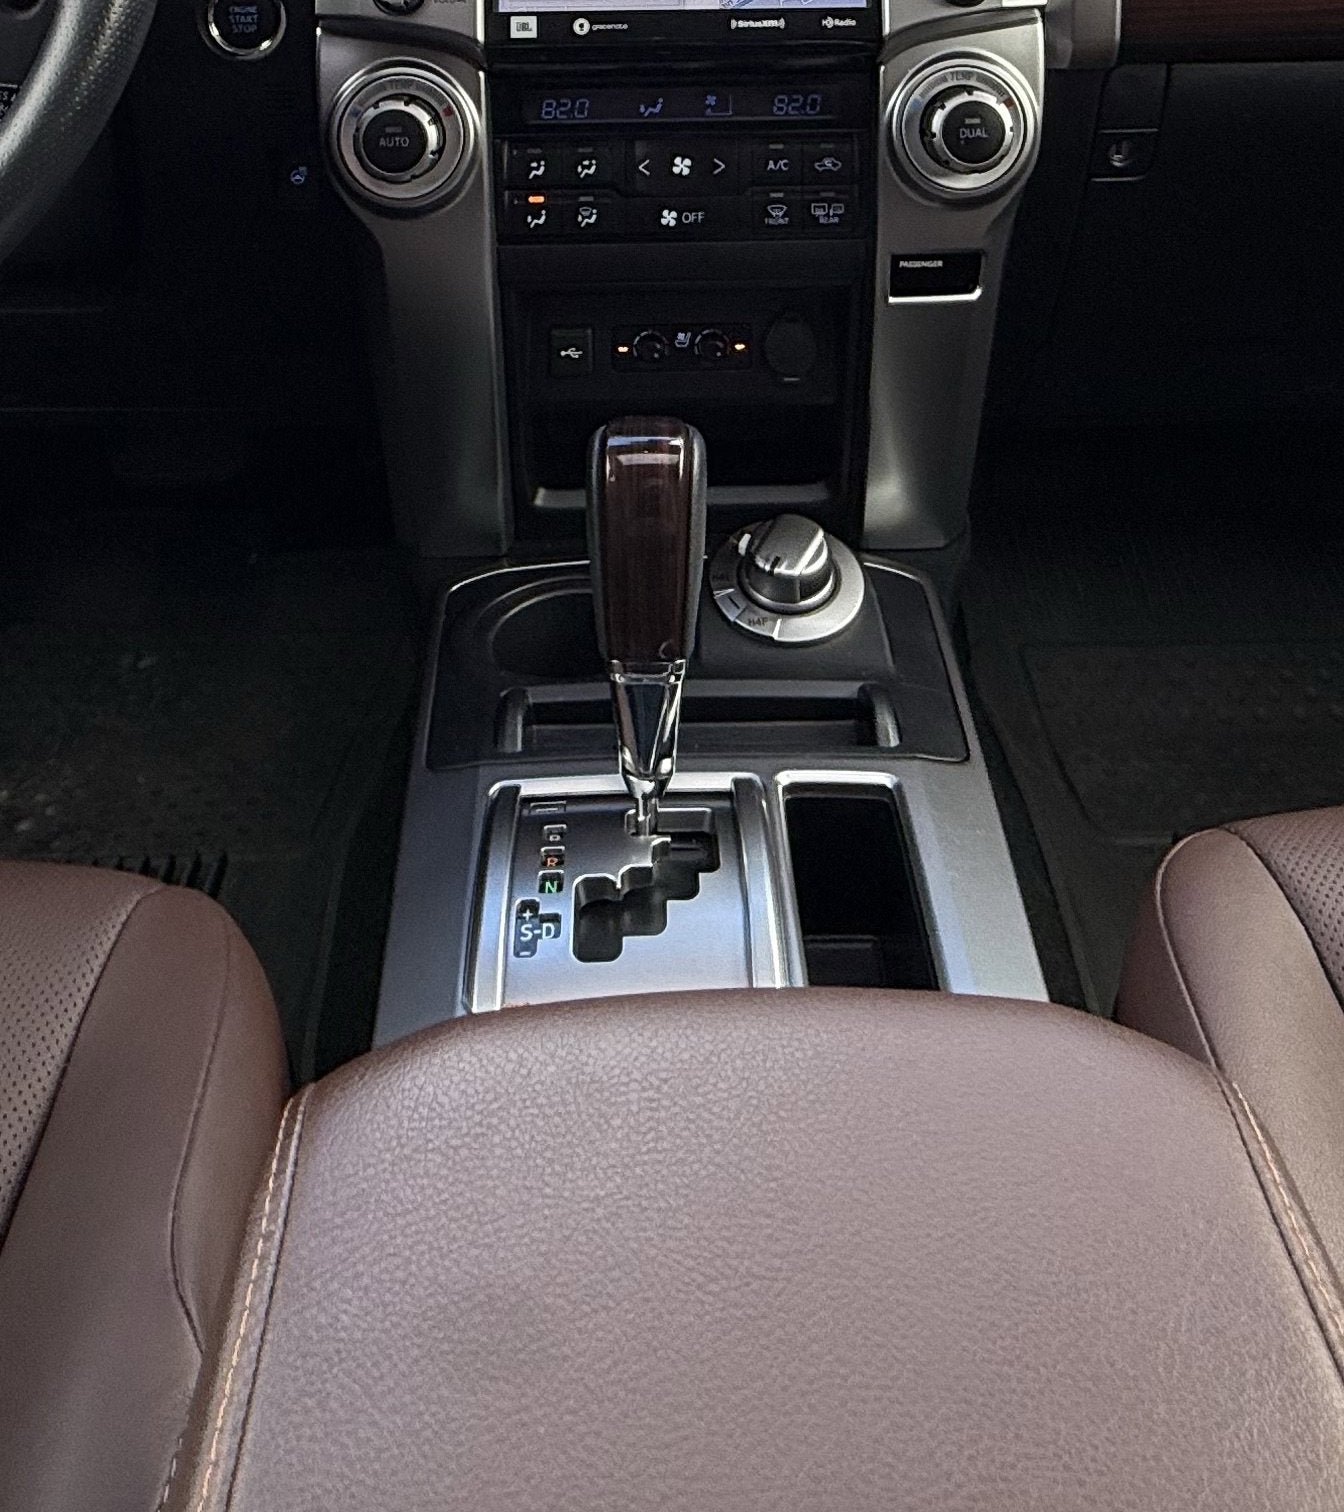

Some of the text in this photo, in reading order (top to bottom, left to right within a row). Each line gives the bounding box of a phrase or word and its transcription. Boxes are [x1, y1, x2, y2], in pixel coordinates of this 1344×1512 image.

[835, 19, 857, 27] Radio
[540, 99, 590, 119] 82.0
[773, 94, 822, 116] 82.0
[959, 128, 989, 139] DUAL
[379, 138, 410, 147] AUTO
[767, 160, 789, 171] A/C
[682, 211, 705, 224] OFF
[899, 260, 944, 268] PASSENGER
[545, 881, 557, 894] N
